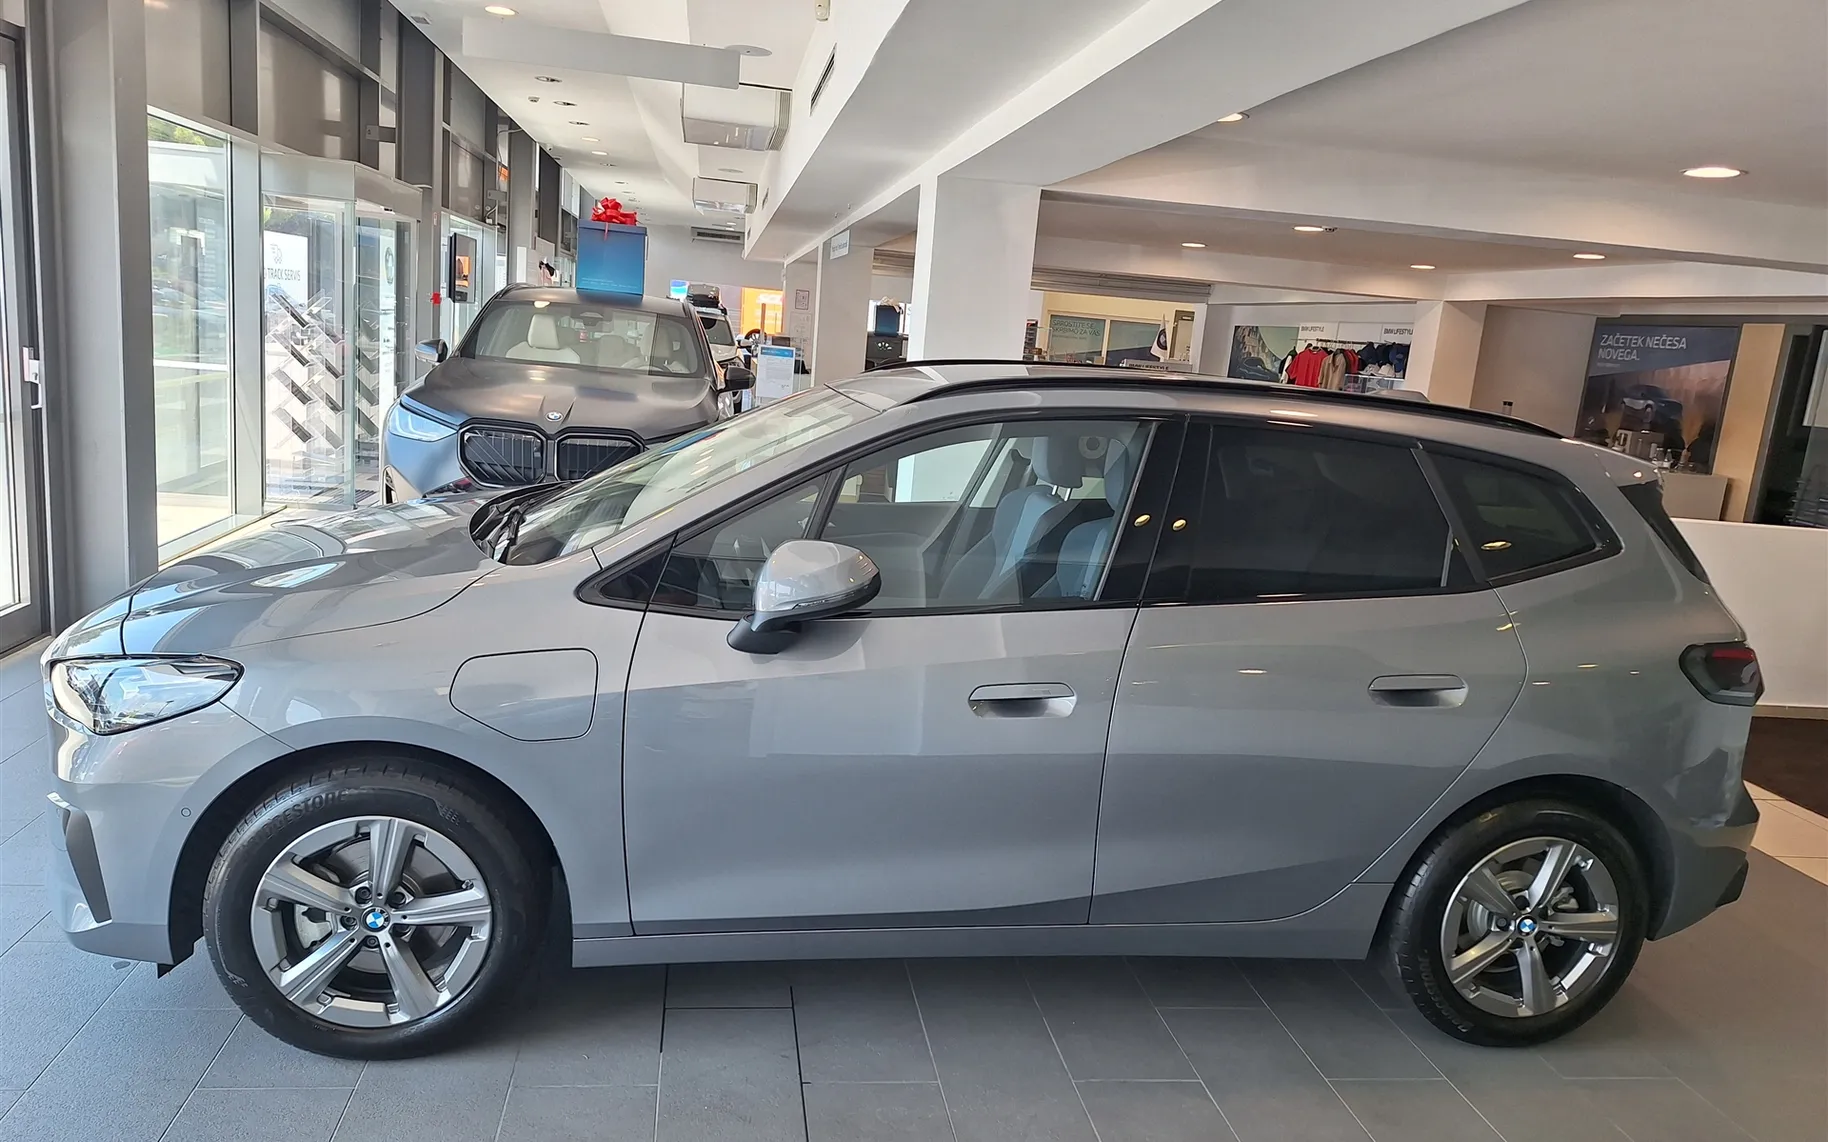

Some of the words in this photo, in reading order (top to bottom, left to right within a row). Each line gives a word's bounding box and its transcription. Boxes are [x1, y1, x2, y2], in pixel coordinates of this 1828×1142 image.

[267, 267, 283, 280] TRACK
[284, 268, 301, 281] SERVIS
[1052, 319, 1086, 329] SPROSTITE
[1393, 328, 1414, 336] LIFESTYL
[1600, 333, 1644, 348] ZAČETEK
[1645, 334, 1687, 350] NEČESA
[1598, 348, 1640, 361] NOVEGA.
